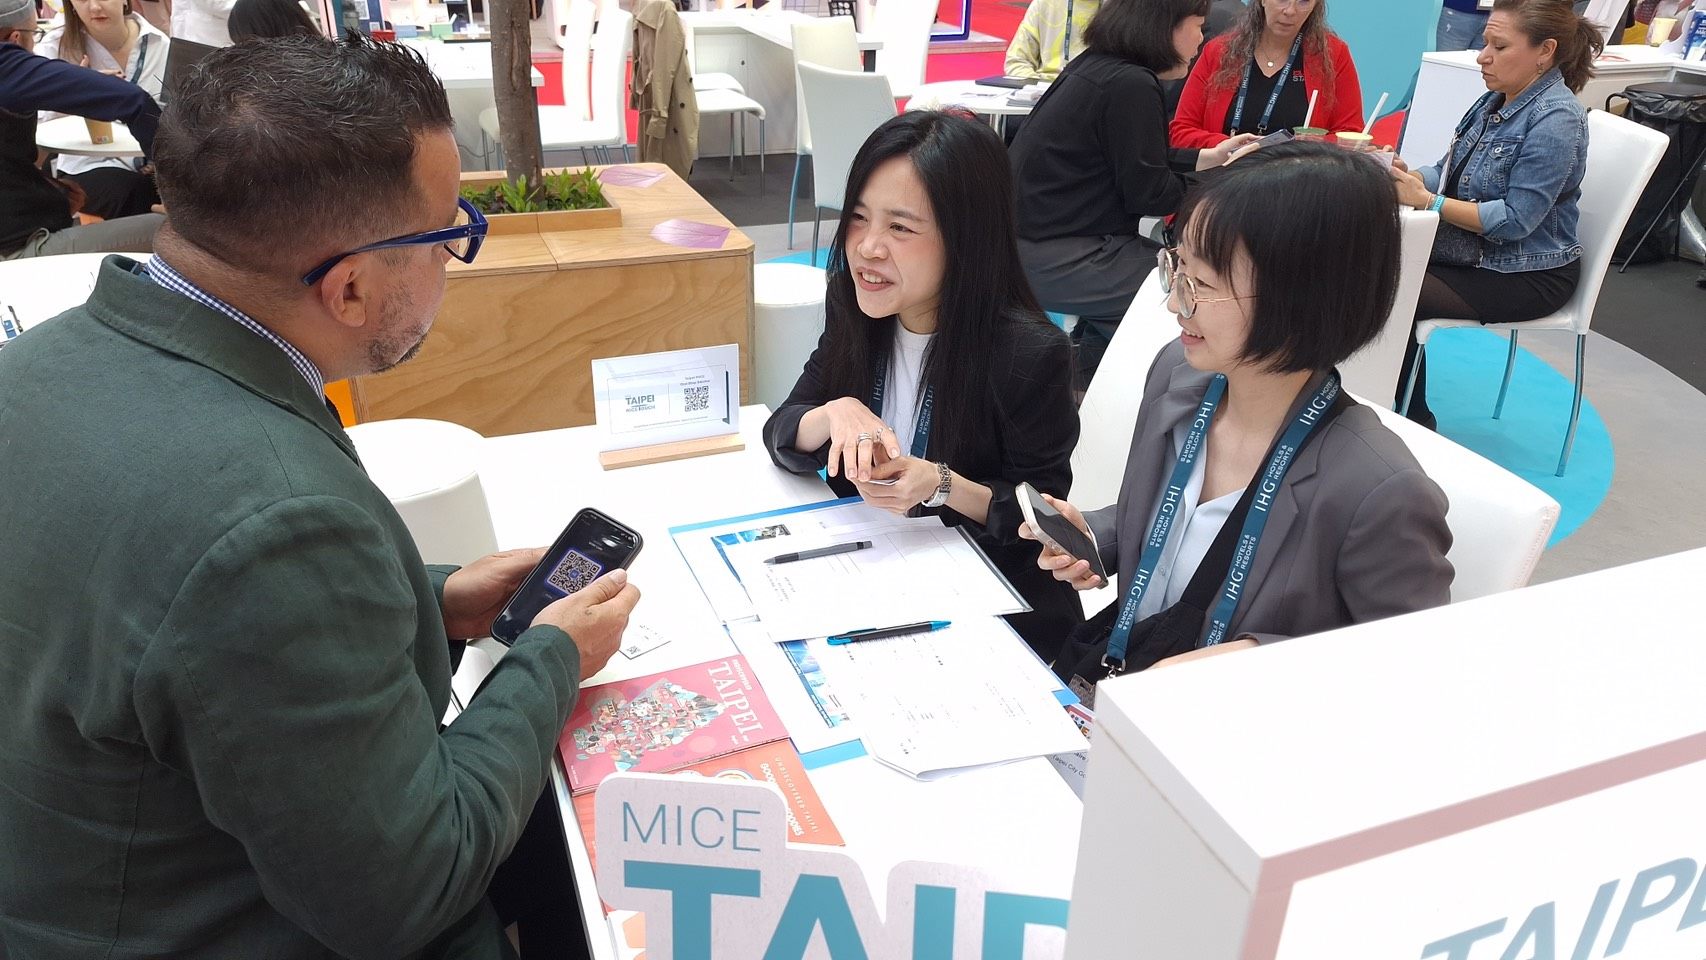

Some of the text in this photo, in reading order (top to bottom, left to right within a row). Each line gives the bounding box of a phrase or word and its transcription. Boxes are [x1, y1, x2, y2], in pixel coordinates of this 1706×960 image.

[625, 394, 655, 405] TAIPEI
[1299, 395, 1327, 426] IHG
[1194, 401, 1214, 431] IHG
[1180, 431, 1196, 462] RESORTS
[1187, 432, 1201, 459] HOTELS
[1267, 449, 1285, 478] HOTELS
[1273, 446, 1294, 480] RESORTS
[1162, 485, 1181, 515] IHG
[1254, 478, 1276, 512] IHG
[1149, 515, 1165, 546] RESORTS
[1156, 516, 1170, 543] HOTELS
[1235, 539, 1249, 567] HOTELS
[1240, 536, 1257, 570] RESORTS
[1131, 568, 1150, 599] IHG
[1225, 567, 1244, 600] IHG
[1117, 598, 1133, 629] RESORTS
[1125, 599, 1138, 626] HOTELS
[1213, 622, 1225, 646] SORTS
[707, 661, 763, 735] TAIPEI
[775, 757, 819, 833] UNDISCOVERED TAIPEI
[622, 801, 761, 852] MICE
